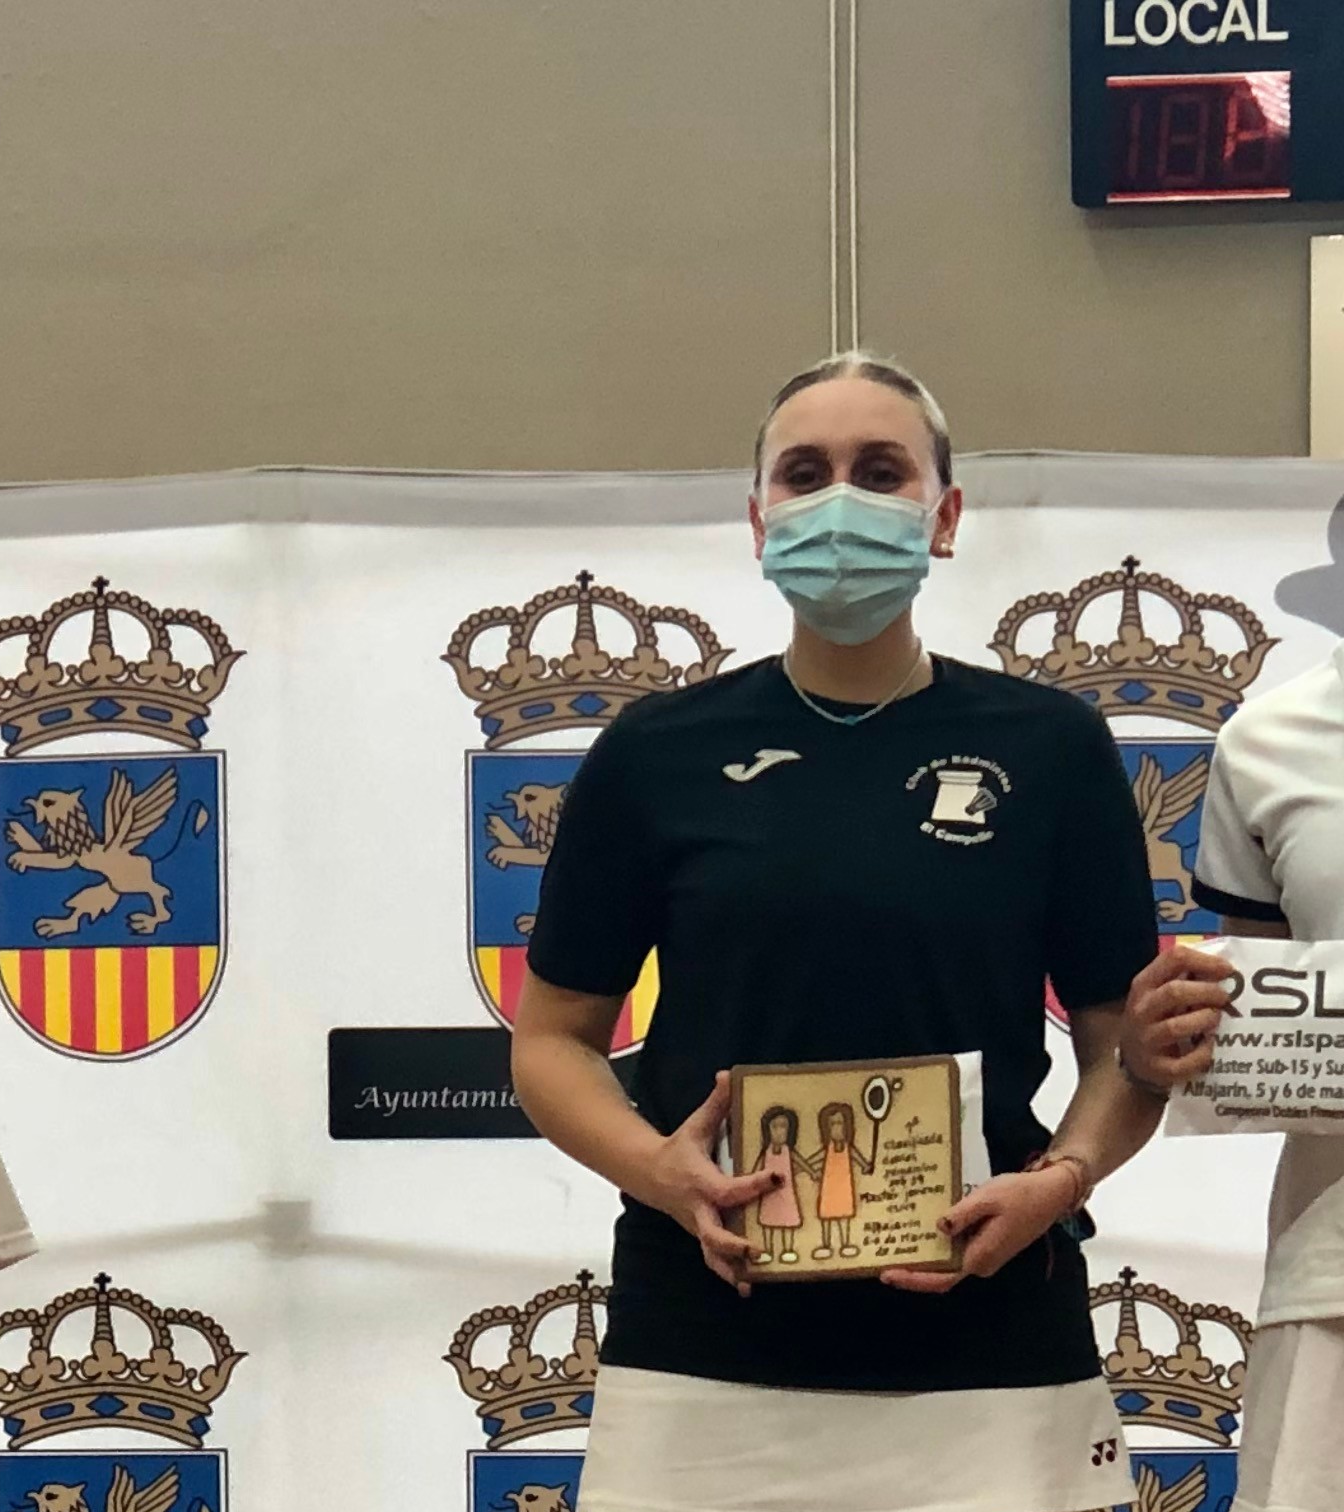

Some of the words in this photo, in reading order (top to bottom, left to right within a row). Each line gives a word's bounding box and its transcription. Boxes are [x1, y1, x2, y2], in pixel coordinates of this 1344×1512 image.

[1104, 0, 1290, 46] LOCAL
[354, 1085, 520, 1117] Ayuntamie
[1268, 1085, 1280, 1103] y
[1282, 1082, 1293, 1099] 6
[1296, 1081, 1316, 1099] de
